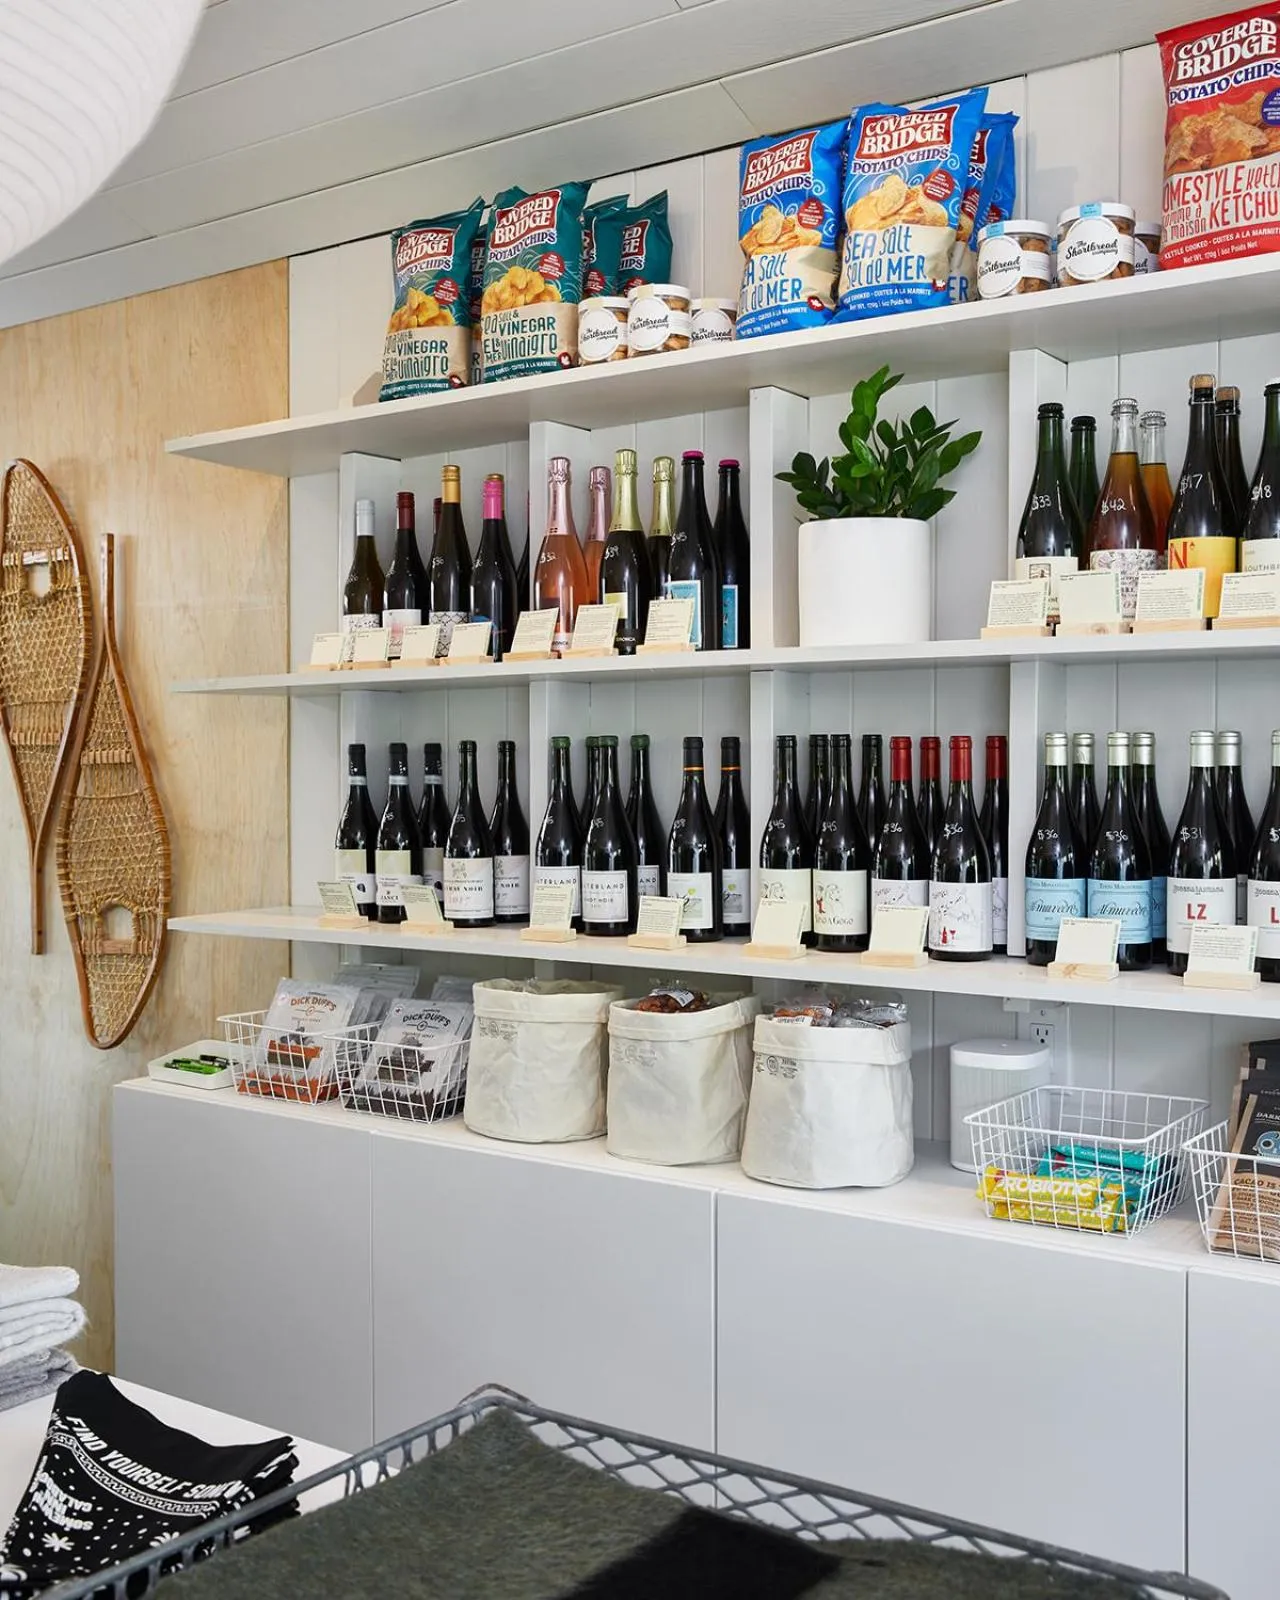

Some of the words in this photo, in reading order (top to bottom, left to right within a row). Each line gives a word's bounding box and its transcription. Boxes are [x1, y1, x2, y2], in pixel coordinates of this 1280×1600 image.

[1178, 17, 1277, 59] COVERED
[1176, 34, 1277, 81] BRIDGE
[1170, 77, 1231, 104] POTATO
[862, 123, 946, 154] BRIDGE
[866, 112, 948, 136] COVERED
[749, 138, 809, 173] COVERED
[852, 156, 906, 174] POTATO
[906, 148, 949, 164] CHIPS
[745, 151, 807, 191] BRIDGE
[741, 185, 774, 207] OTATO
[775, 175, 813, 193] CHIPS
[494, 211, 552, 244] BRIDGE
[397, 239, 449, 268] BRIDGE
[489, 242, 523, 261] POTATO
[524, 231, 557, 247] CHIPS
[845, 232, 878, 264] SEA
[1065, 238, 1119, 260] Shortbread
[886, 254, 928, 282] MER
[766, 277, 803, 306] MER
[498, 316, 556, 337] VINEGAR
[690, 328, 733, 342] Shortbread
[397, 340, 449, 357] VINEGAR
[1101, 497, 1127, 516] $42
[1187, 903, 1208, 920] LZ
[402, 1013, 424, 1023] DICK
[66, 1416, 108, 1452] FIND
[100, 1449, 193, 1494] YOURSELF
